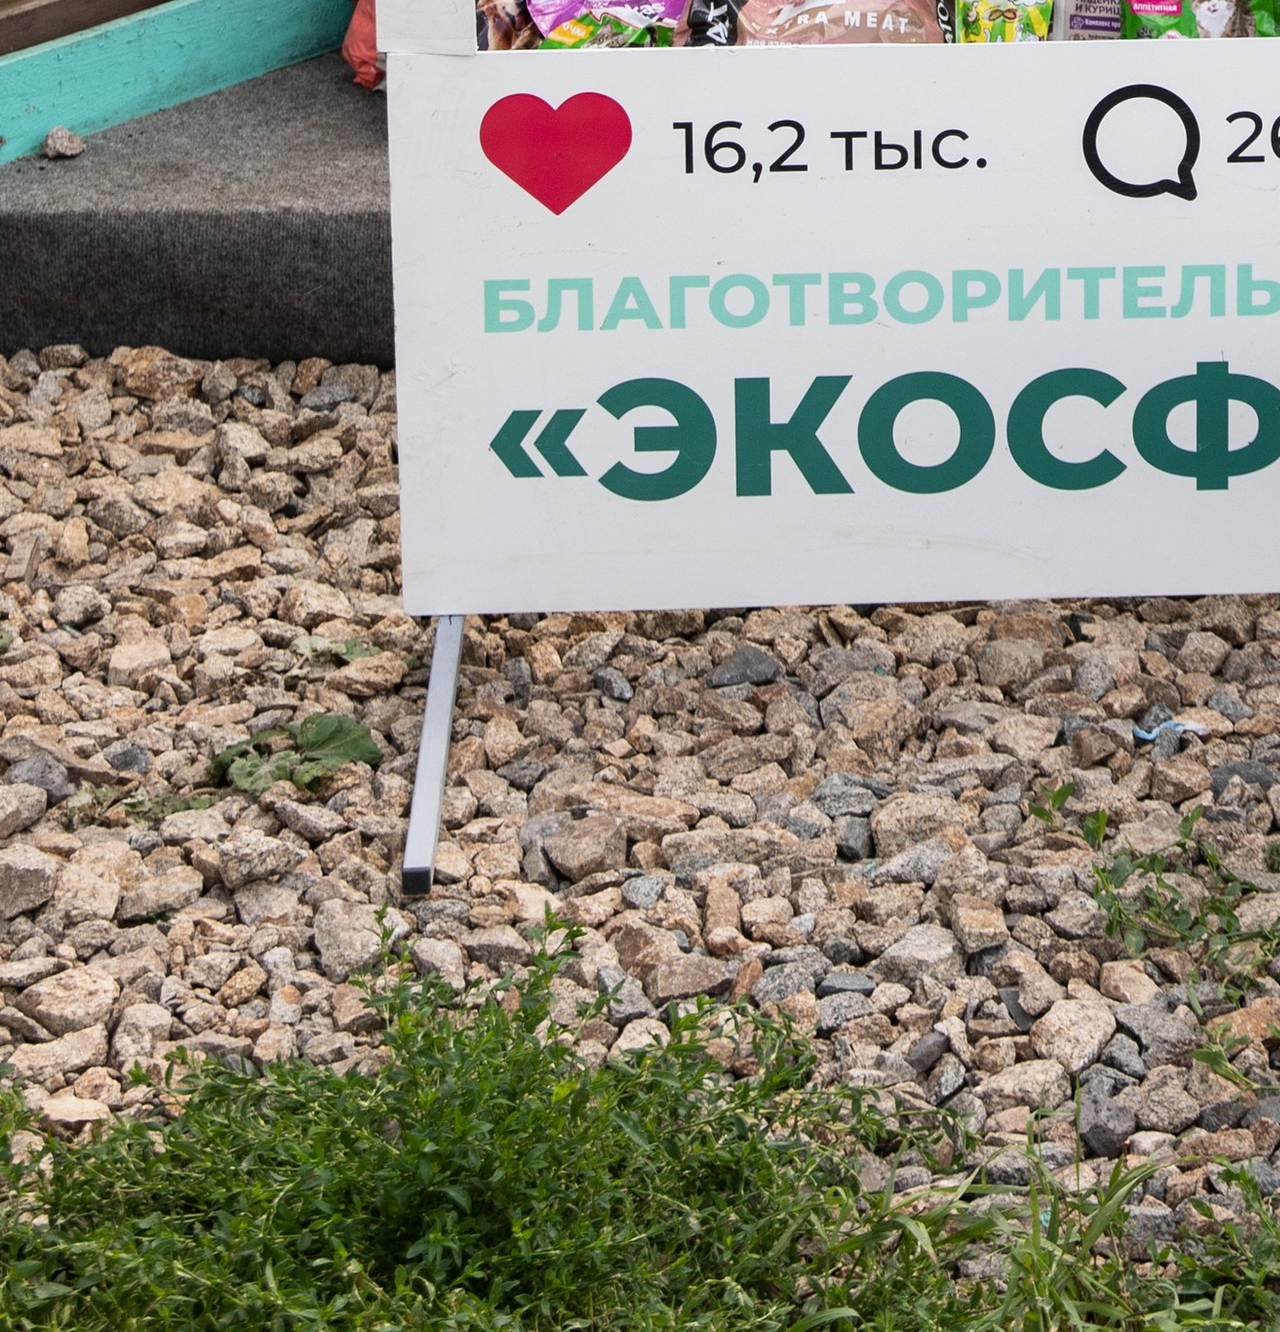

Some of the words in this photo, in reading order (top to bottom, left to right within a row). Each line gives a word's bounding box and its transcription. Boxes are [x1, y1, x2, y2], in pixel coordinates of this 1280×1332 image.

[843, 10, 910, 35] MEAT
[1084, 5, 1120, 16] КУРИЦ
[671, 119, 810, 184] 16,2
[829, 126, 988, 173] тыс.
